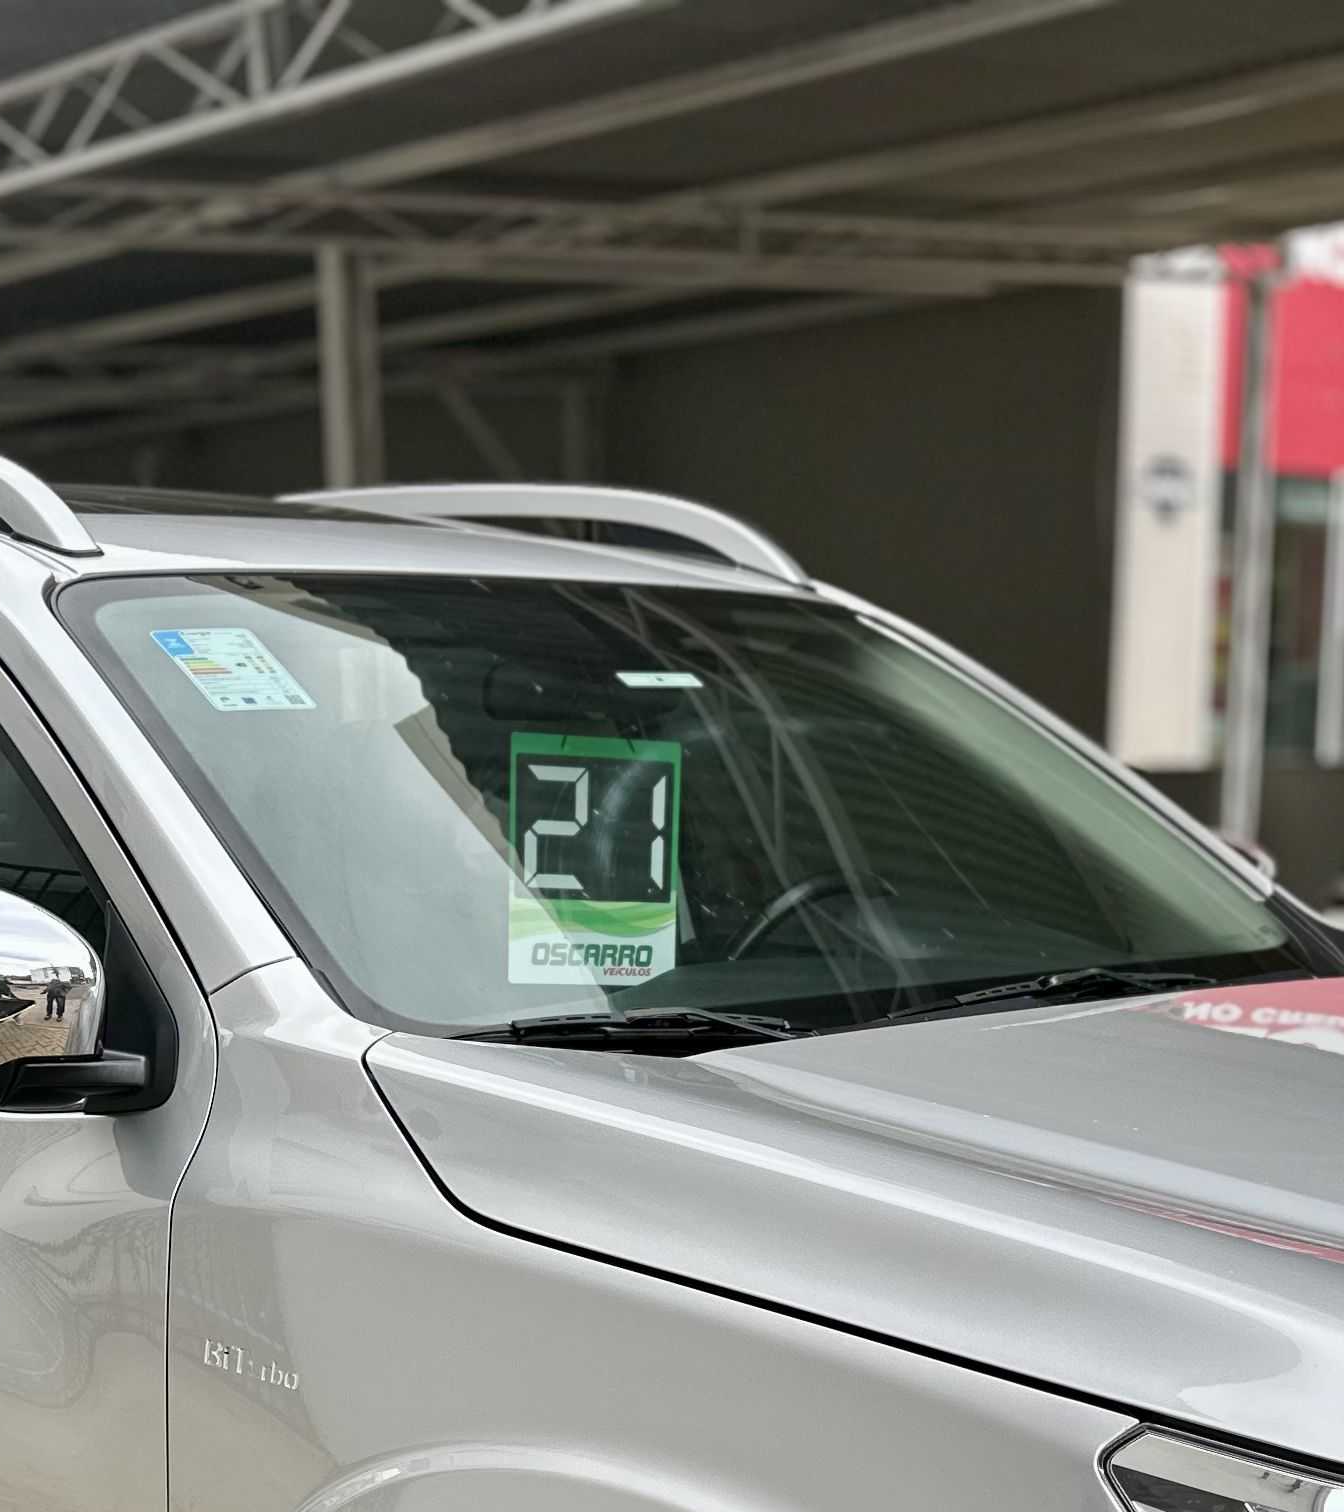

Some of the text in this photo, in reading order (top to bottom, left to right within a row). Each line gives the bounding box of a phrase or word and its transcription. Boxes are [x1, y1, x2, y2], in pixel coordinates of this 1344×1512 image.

[524, 764, 666, 891] 21
[531, 942, 653, 967] OSCARRO
[203, 1338, 299, 1391] BiTrbo
